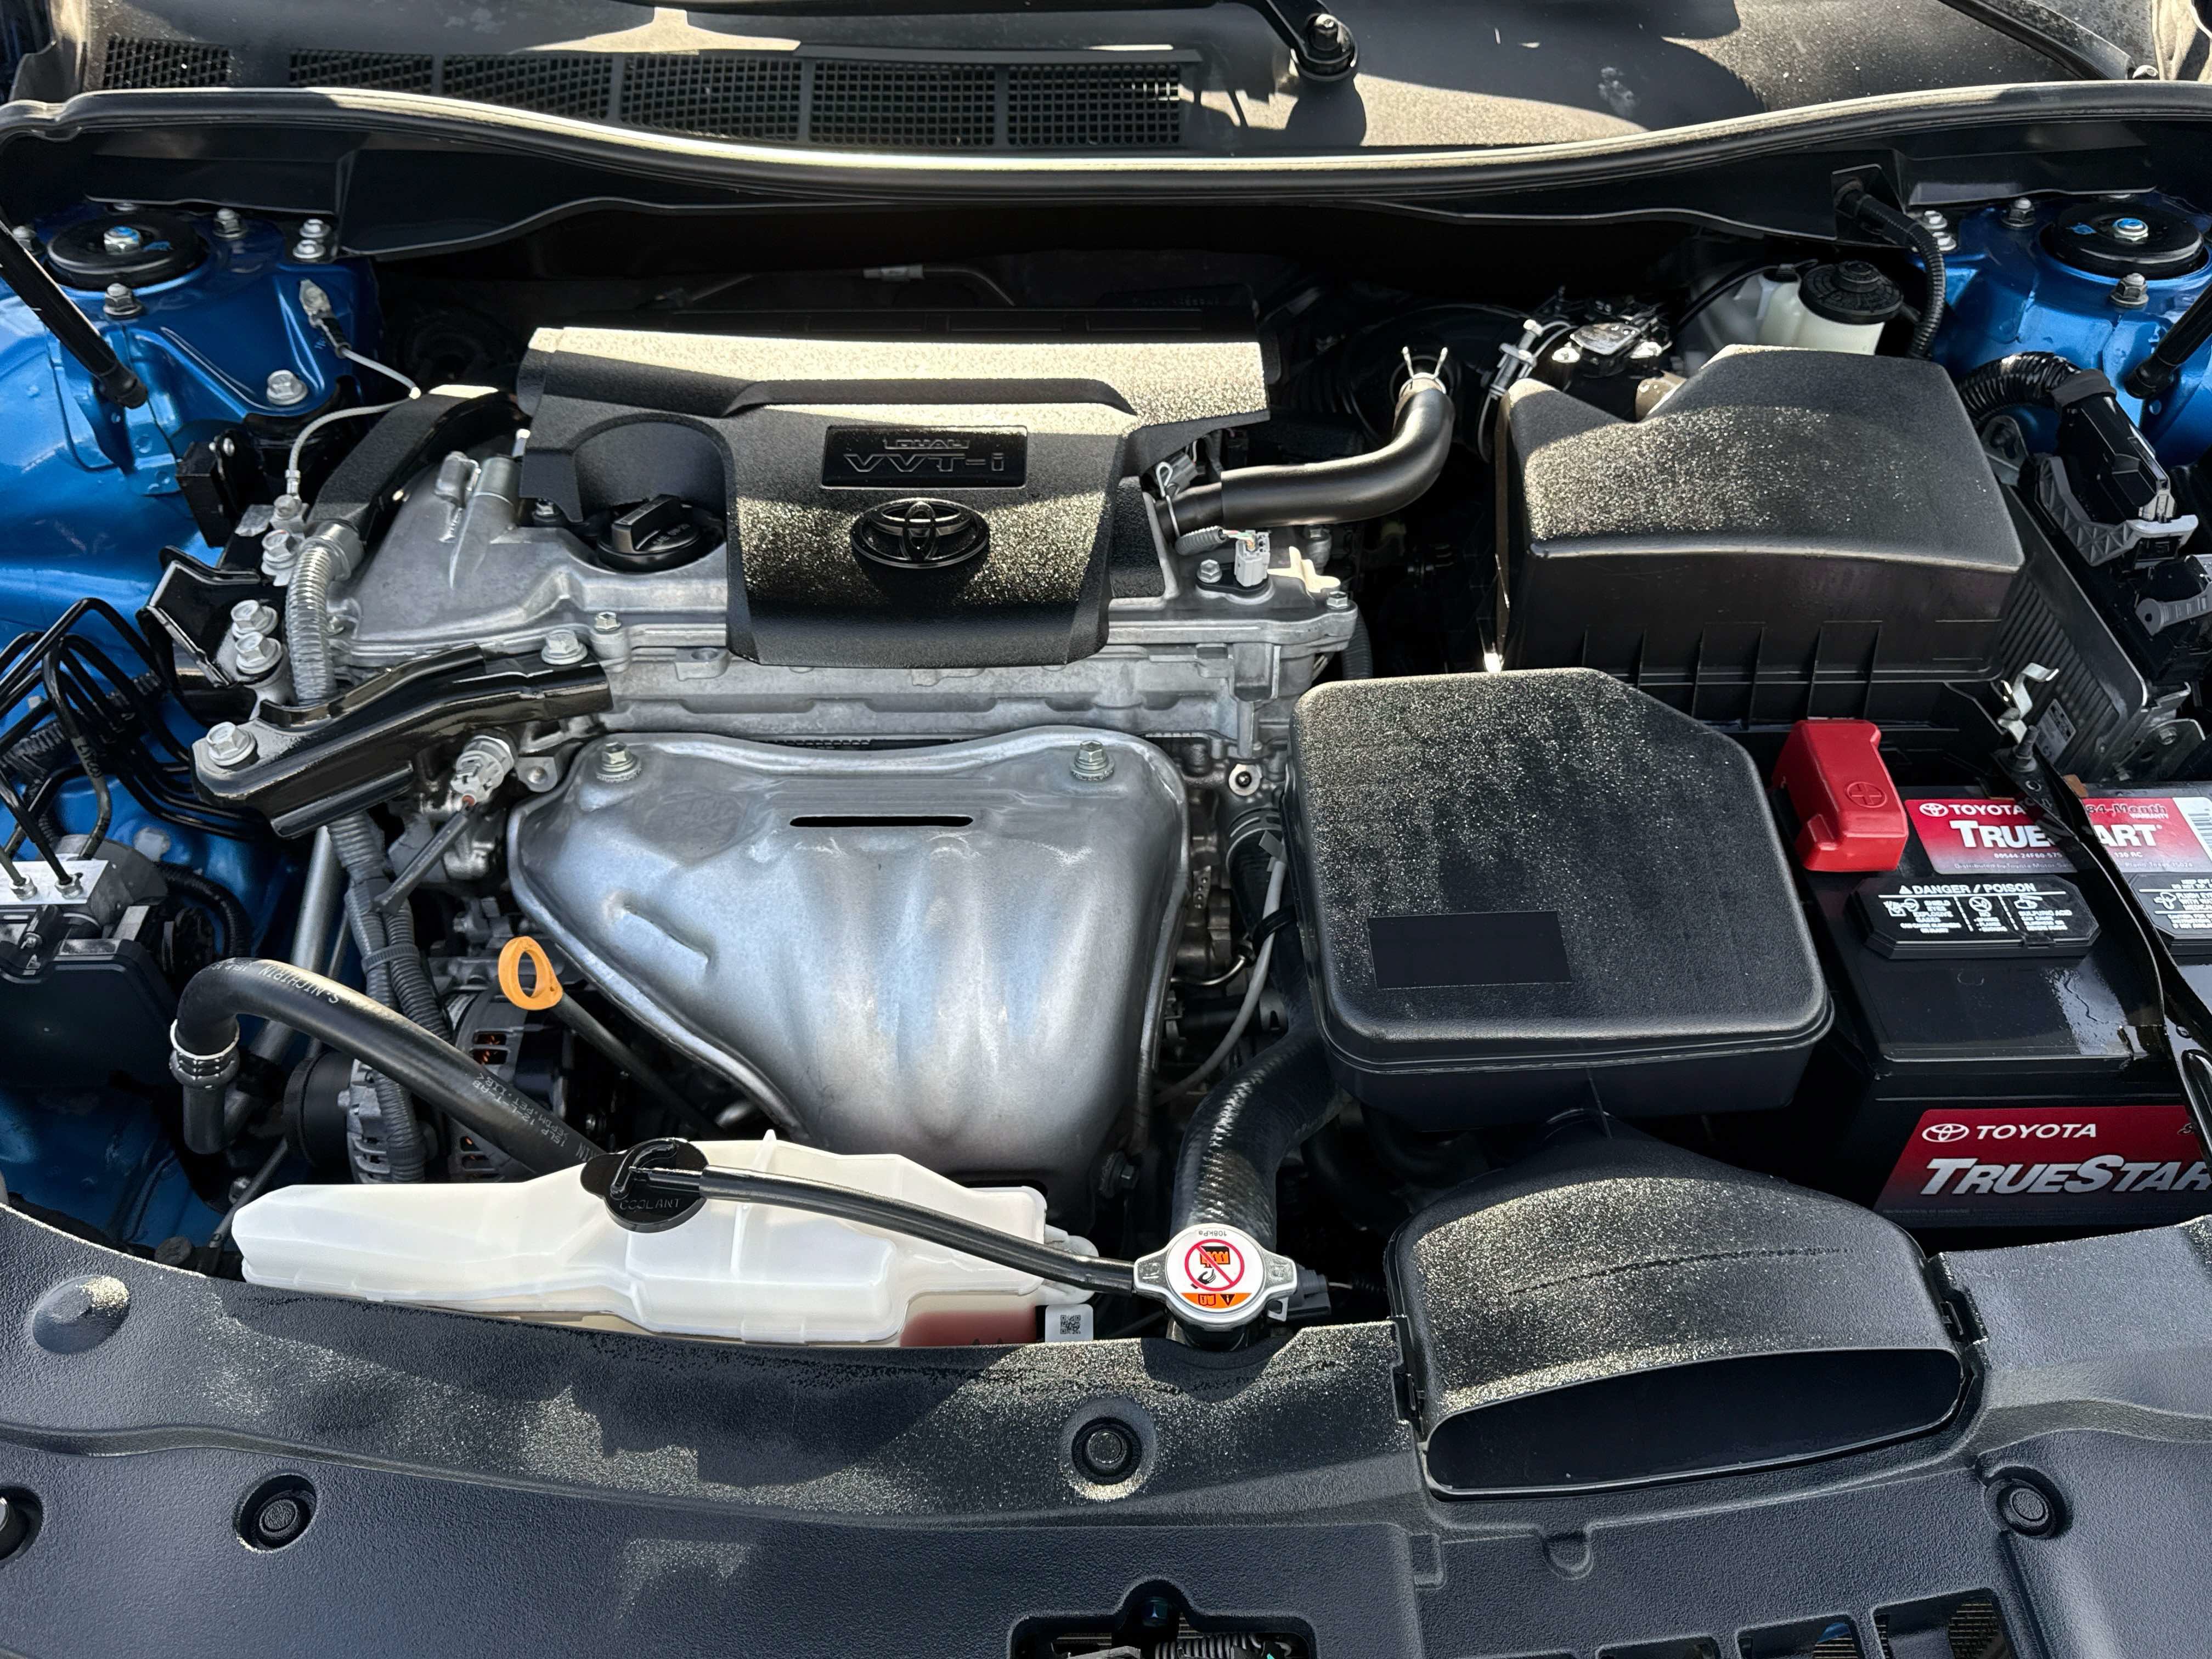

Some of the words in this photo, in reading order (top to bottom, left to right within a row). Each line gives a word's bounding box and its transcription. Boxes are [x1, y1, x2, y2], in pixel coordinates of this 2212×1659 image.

[844, 453, 1004, 472] VVT-i
[1948, 804, 2027, 815] TOYOTA
[1949, 820, 2157, 848] TRUEART
[1912, 885, 1971, 894] DANGER
[1983, 883, 2036, 893] POISON
[1976, 1124, 2097, 1140] TOYOTA
[1920, 1155, 2212, 1195] TRUESTAR
[619, 1198, 681, 1210] COOLANT
